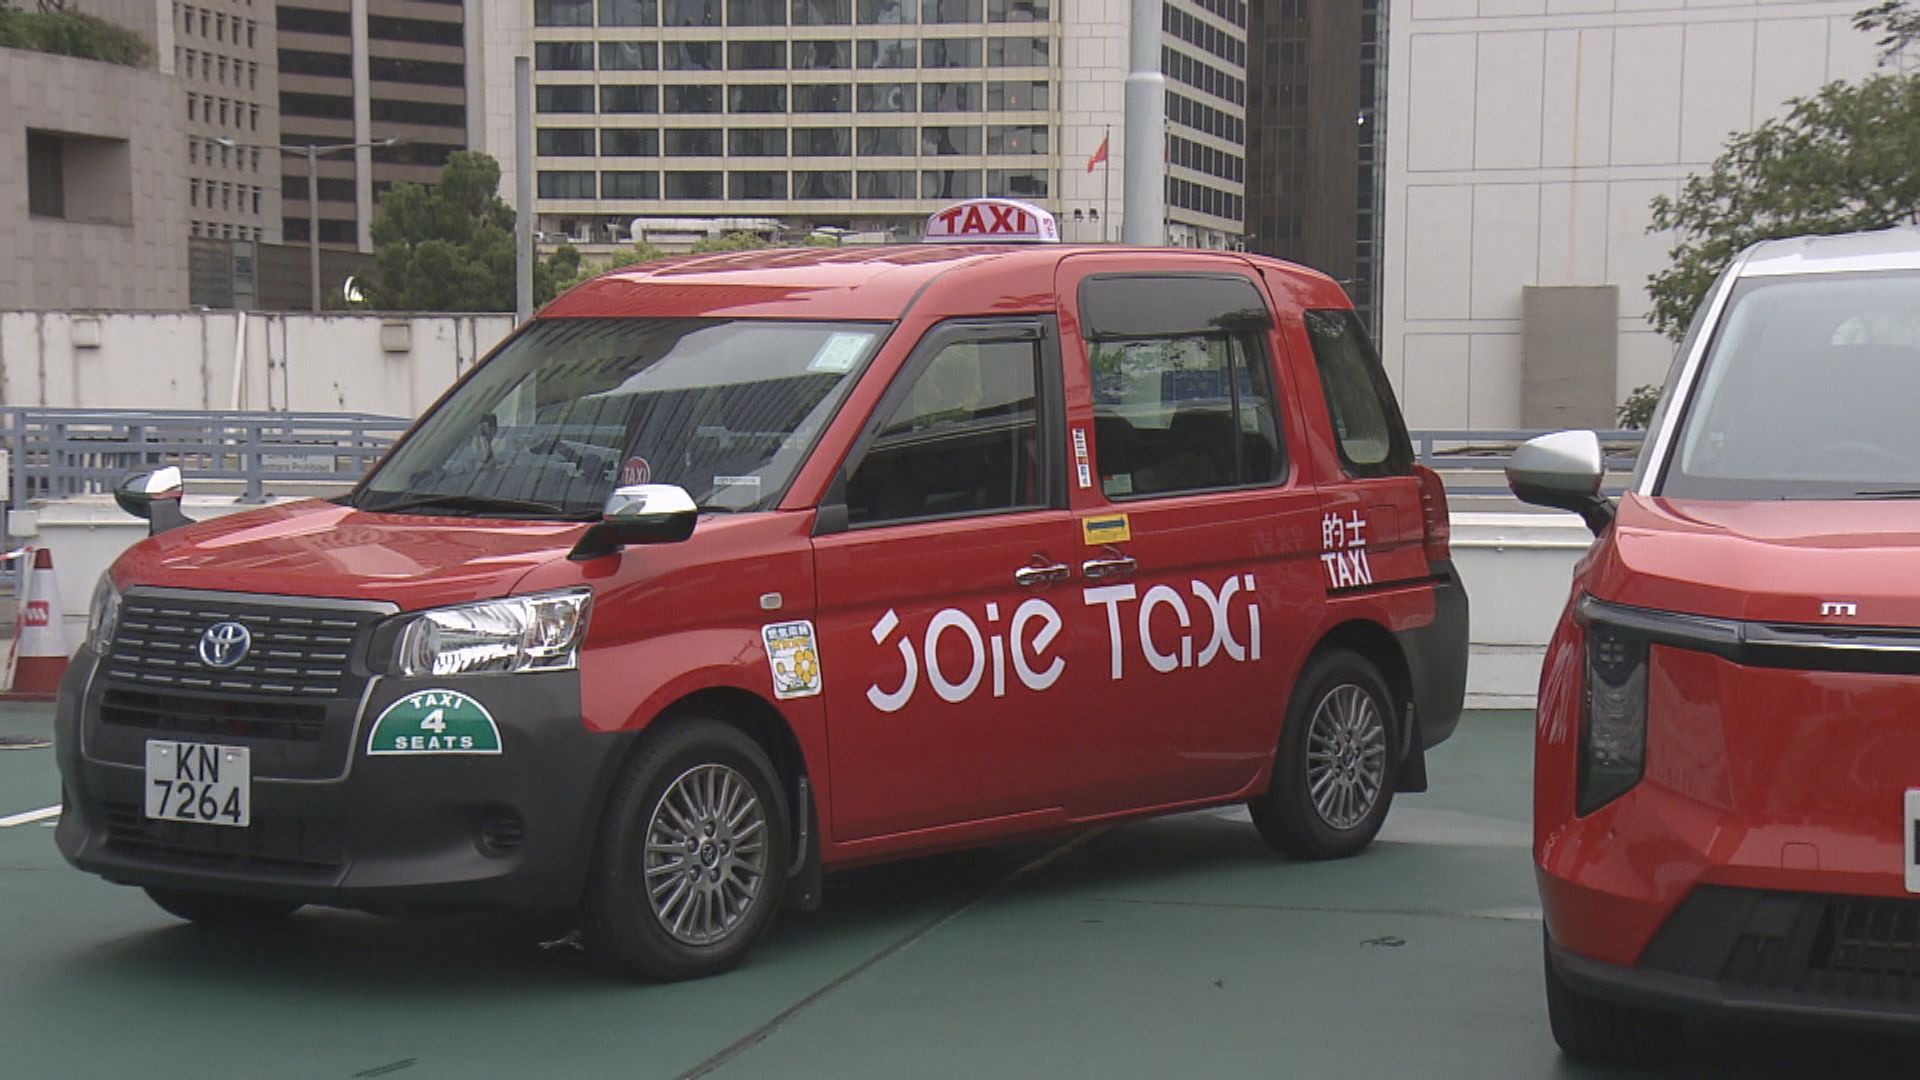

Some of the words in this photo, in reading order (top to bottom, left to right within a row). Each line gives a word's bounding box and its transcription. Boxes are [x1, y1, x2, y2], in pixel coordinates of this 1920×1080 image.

[940, 205, 1026, 234] TAXI
[623, 467, 648, 484] TAXI
[1322, 510, 1367, 549] 的士
[1320, 548, 1373, 588] TAXI
[410, 692, 464, 711] TAXI
[421, 710, 446, 733] 4
[395, 735, 474, 751] SEATS
[176, 744, 219, 783] KN
[153, 780, 241, 823] 7264
